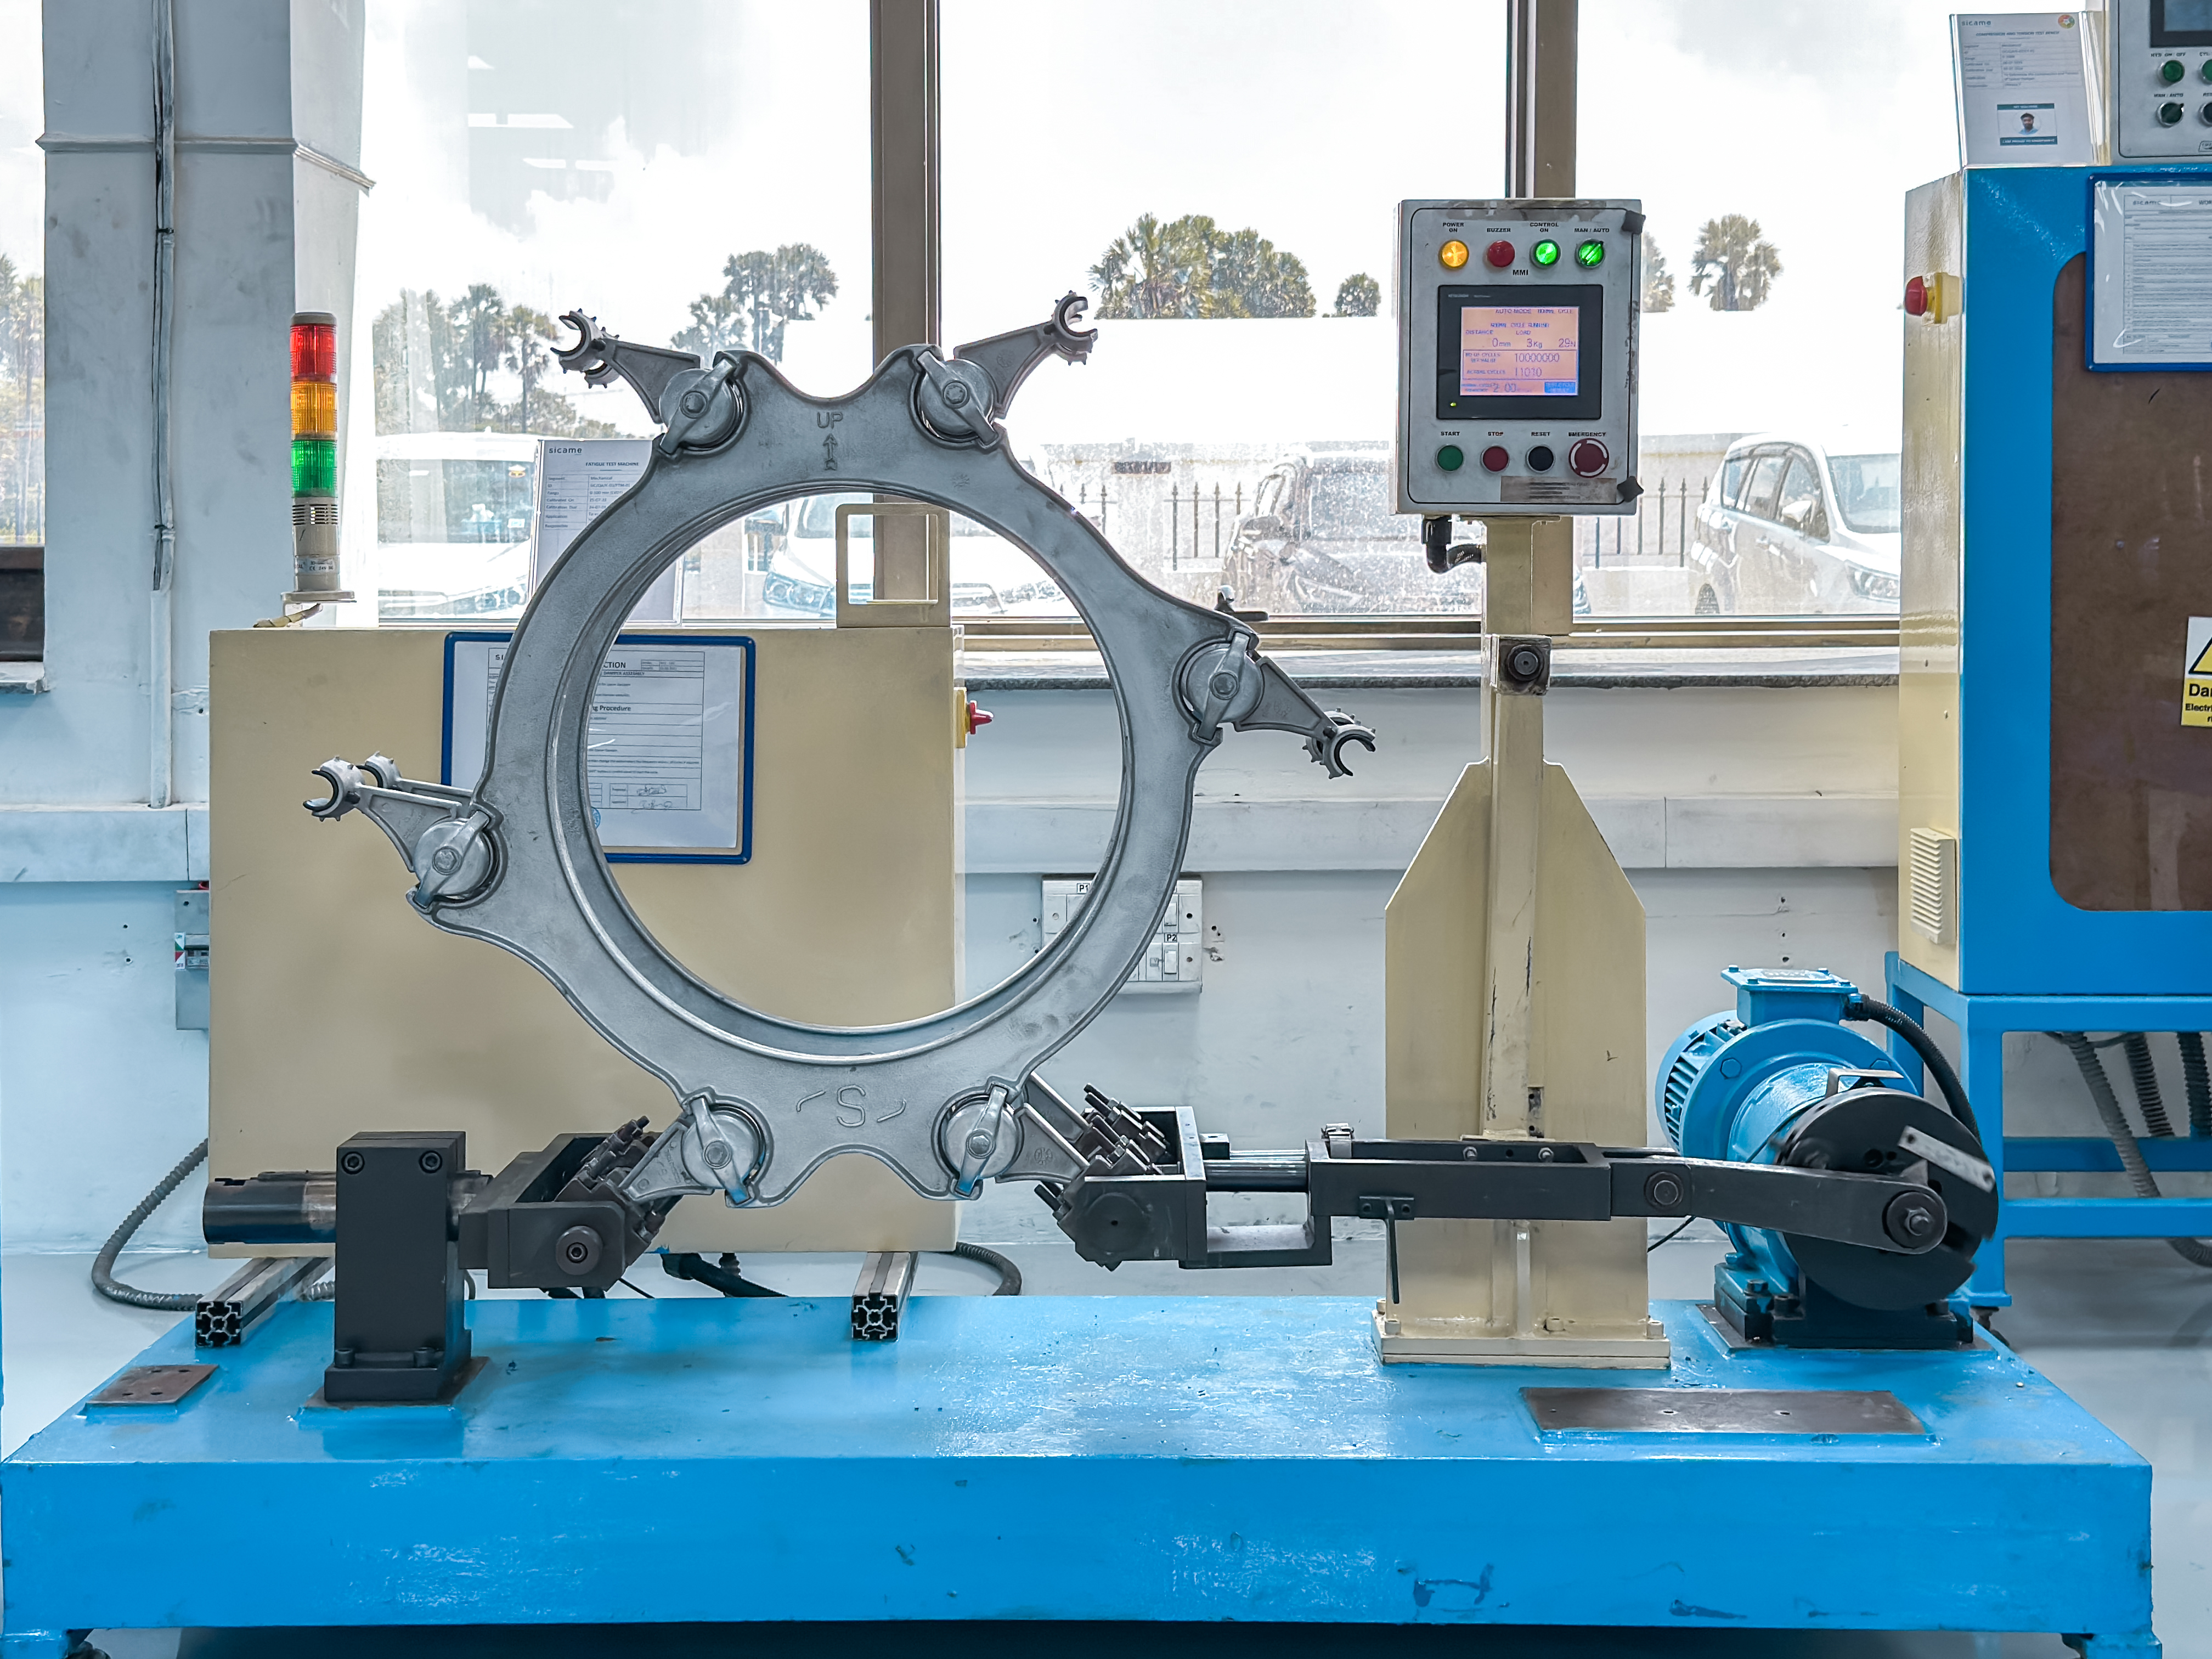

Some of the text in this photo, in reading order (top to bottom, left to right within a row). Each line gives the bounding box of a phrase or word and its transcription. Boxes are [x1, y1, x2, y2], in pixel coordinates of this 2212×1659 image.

[1515, 353, 1560, 363] 10000000
[817, 412, 843, 428] UP
[2189, 684, 2212, 697] Da
[2186, 703, 2212, 712] Electri
